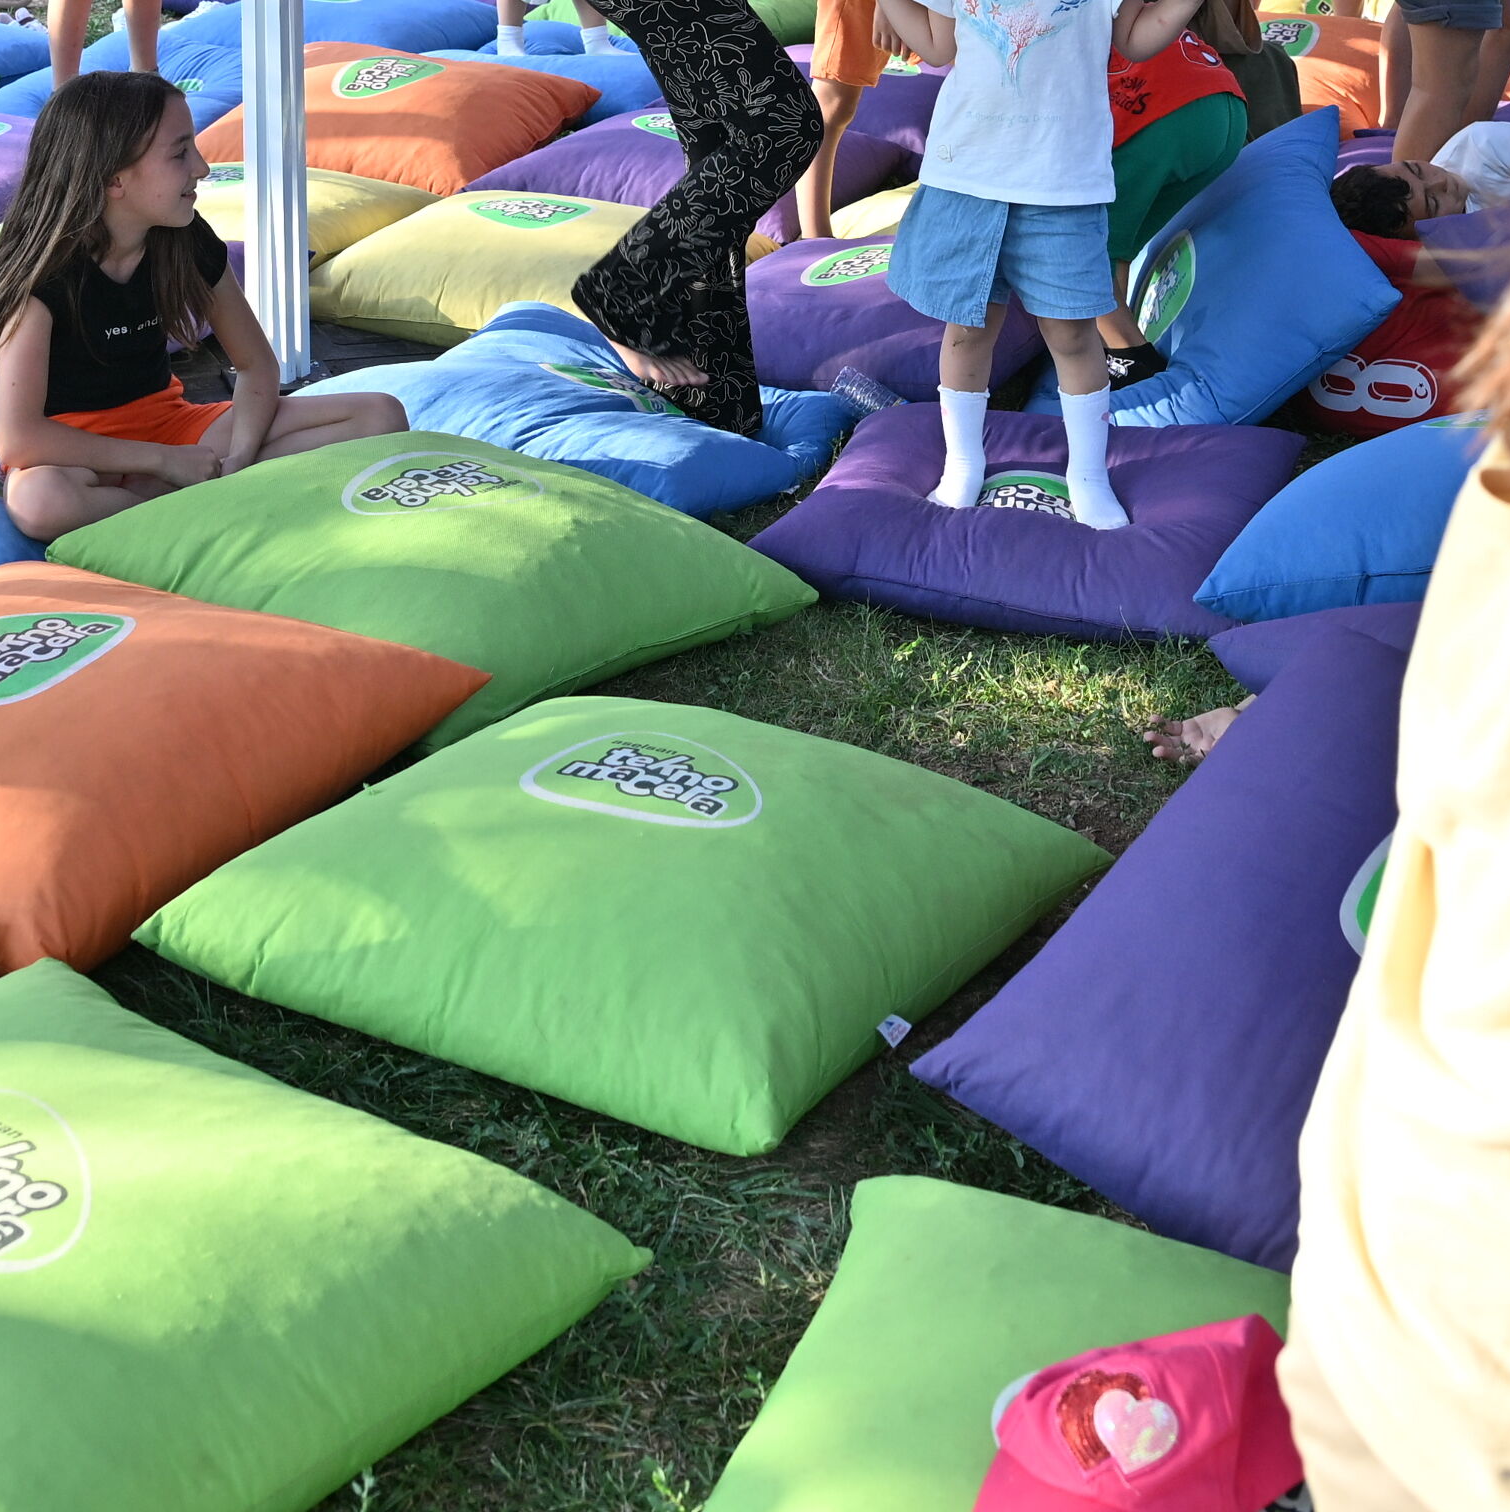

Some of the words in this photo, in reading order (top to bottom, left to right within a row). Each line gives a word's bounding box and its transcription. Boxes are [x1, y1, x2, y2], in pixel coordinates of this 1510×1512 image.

[360, 461, 488, 502] macera
[395, 472, 505, 509] tekno
[610, 738, 679, 756] aselsan
[556, 759, 726, 817] macera
[597, 746, 739, 796] tekno
